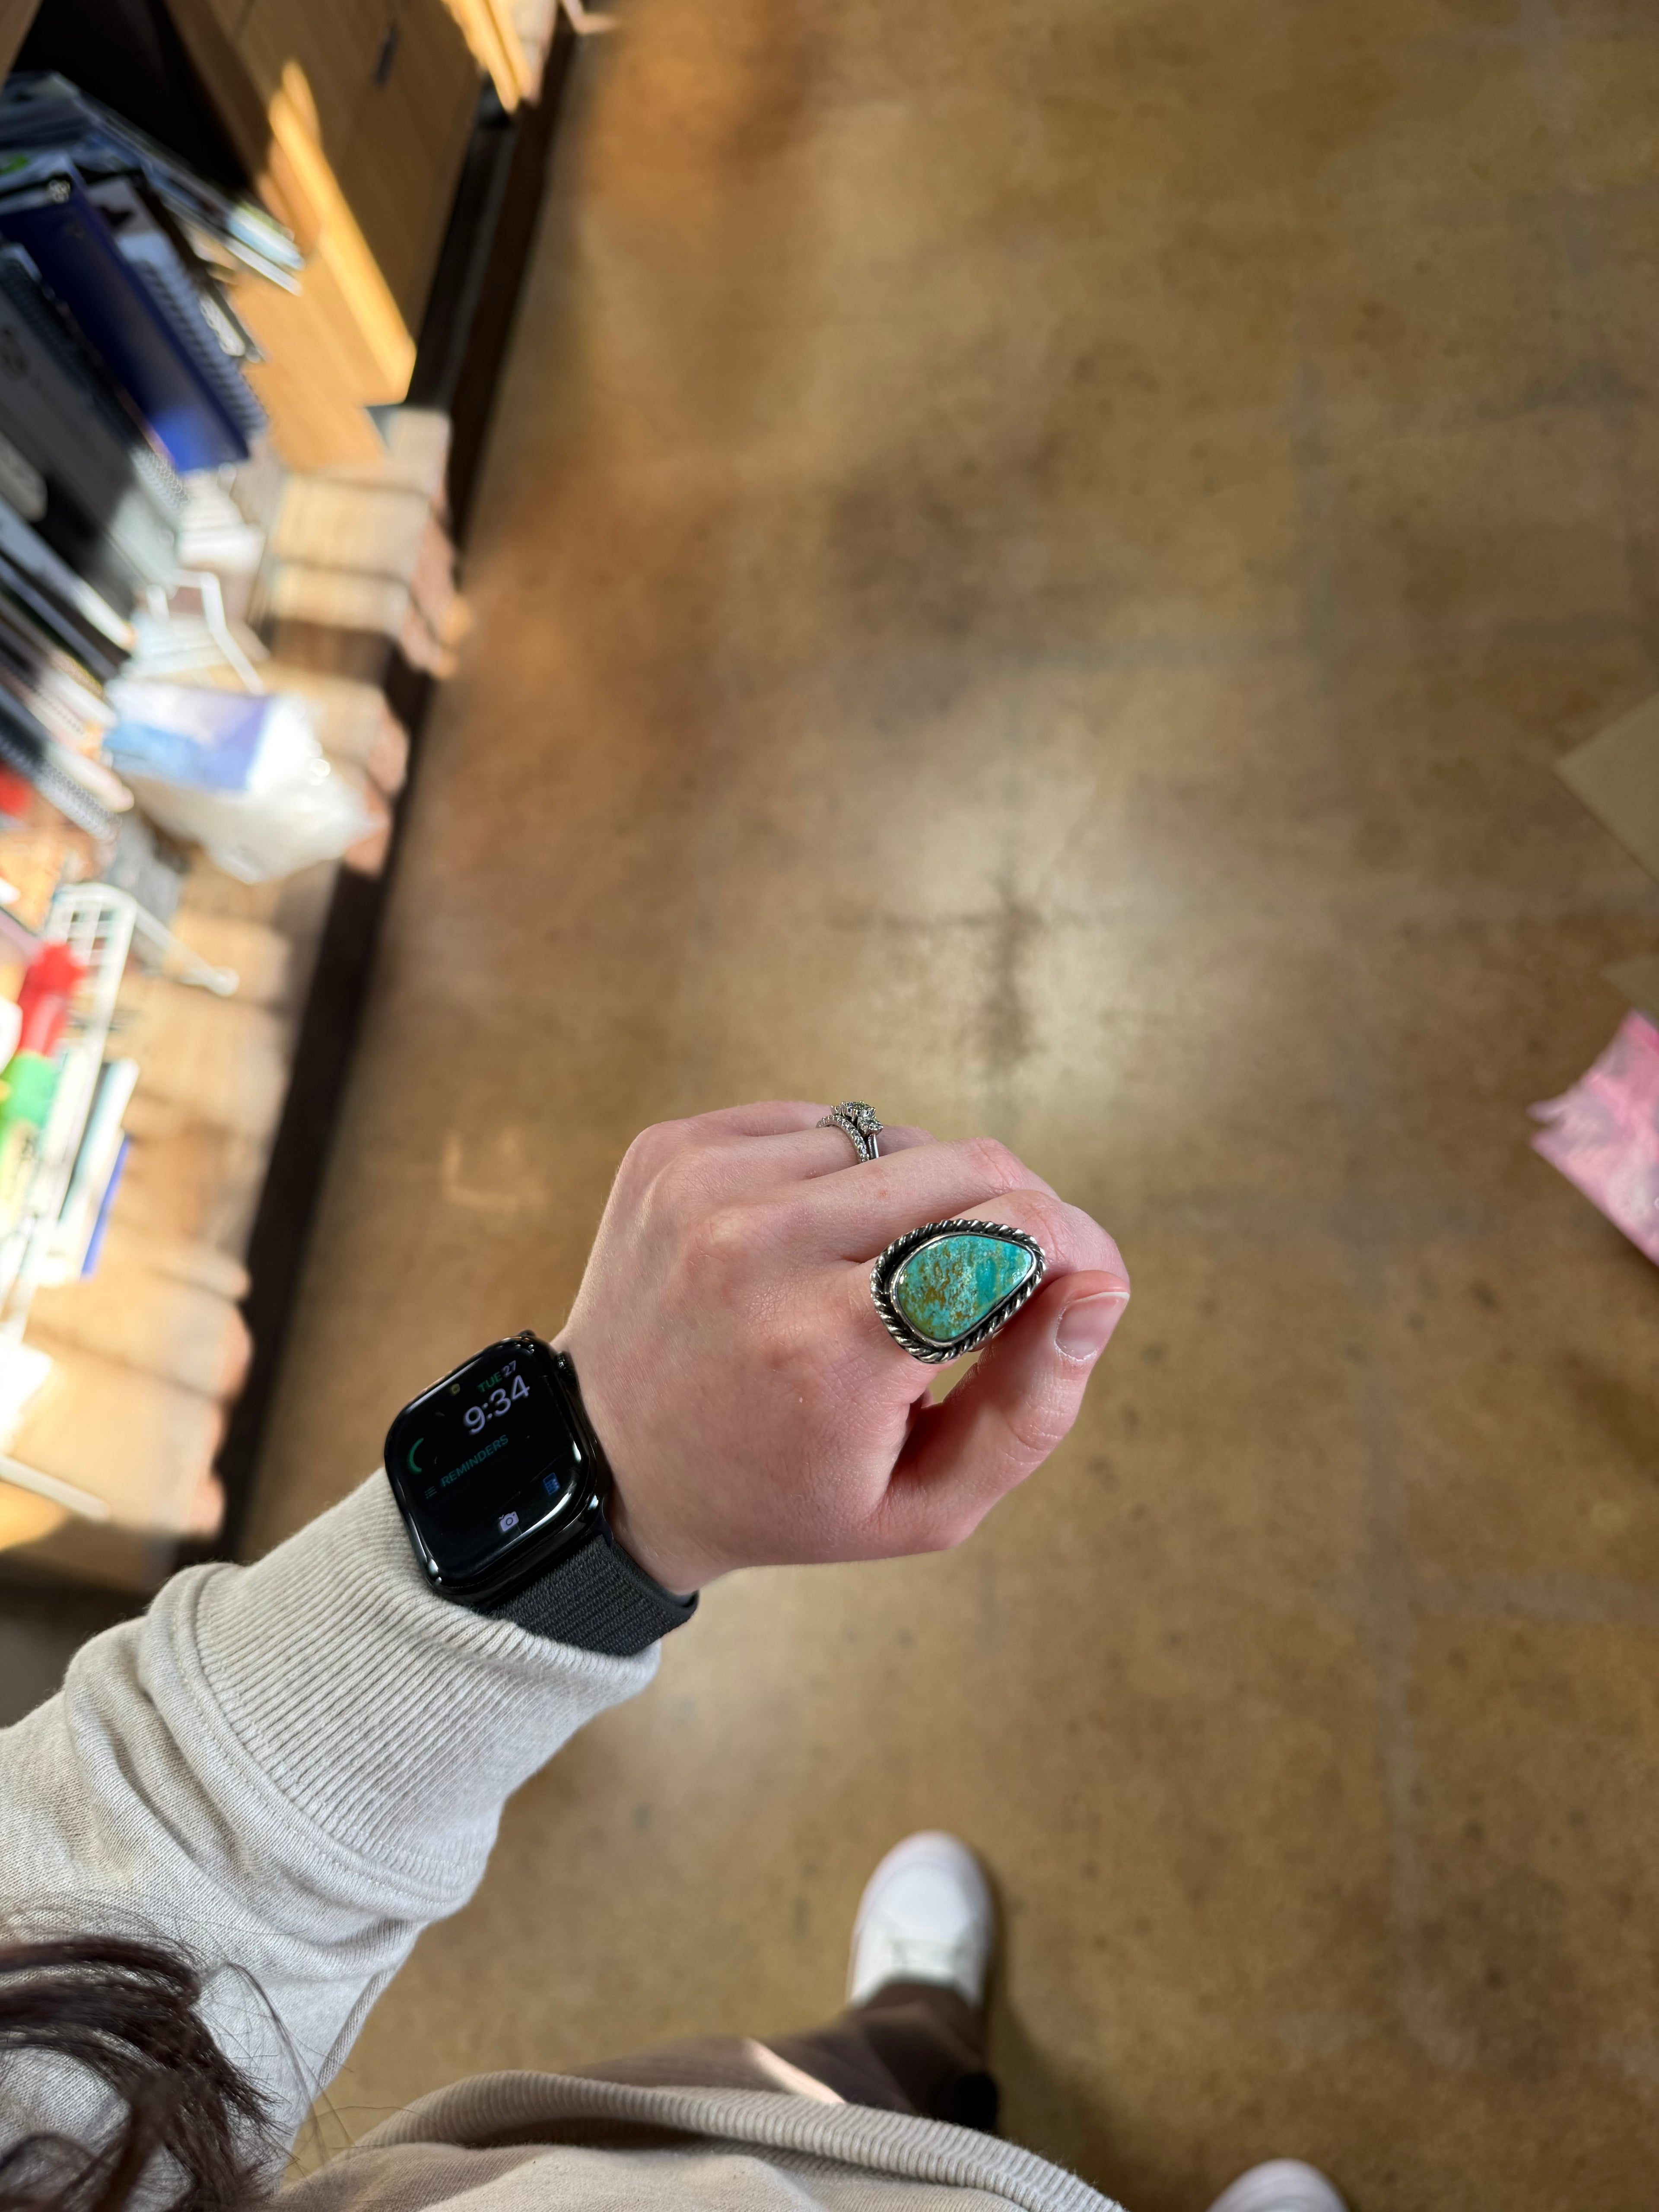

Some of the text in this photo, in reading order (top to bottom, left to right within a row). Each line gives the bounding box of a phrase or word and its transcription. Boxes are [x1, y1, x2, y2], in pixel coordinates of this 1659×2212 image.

[477, 1360, 517, 1392] TUE 27
[464, 1375, 530, 1435] 9:34
[440, 1434, 509, 1487] REMINDERS
